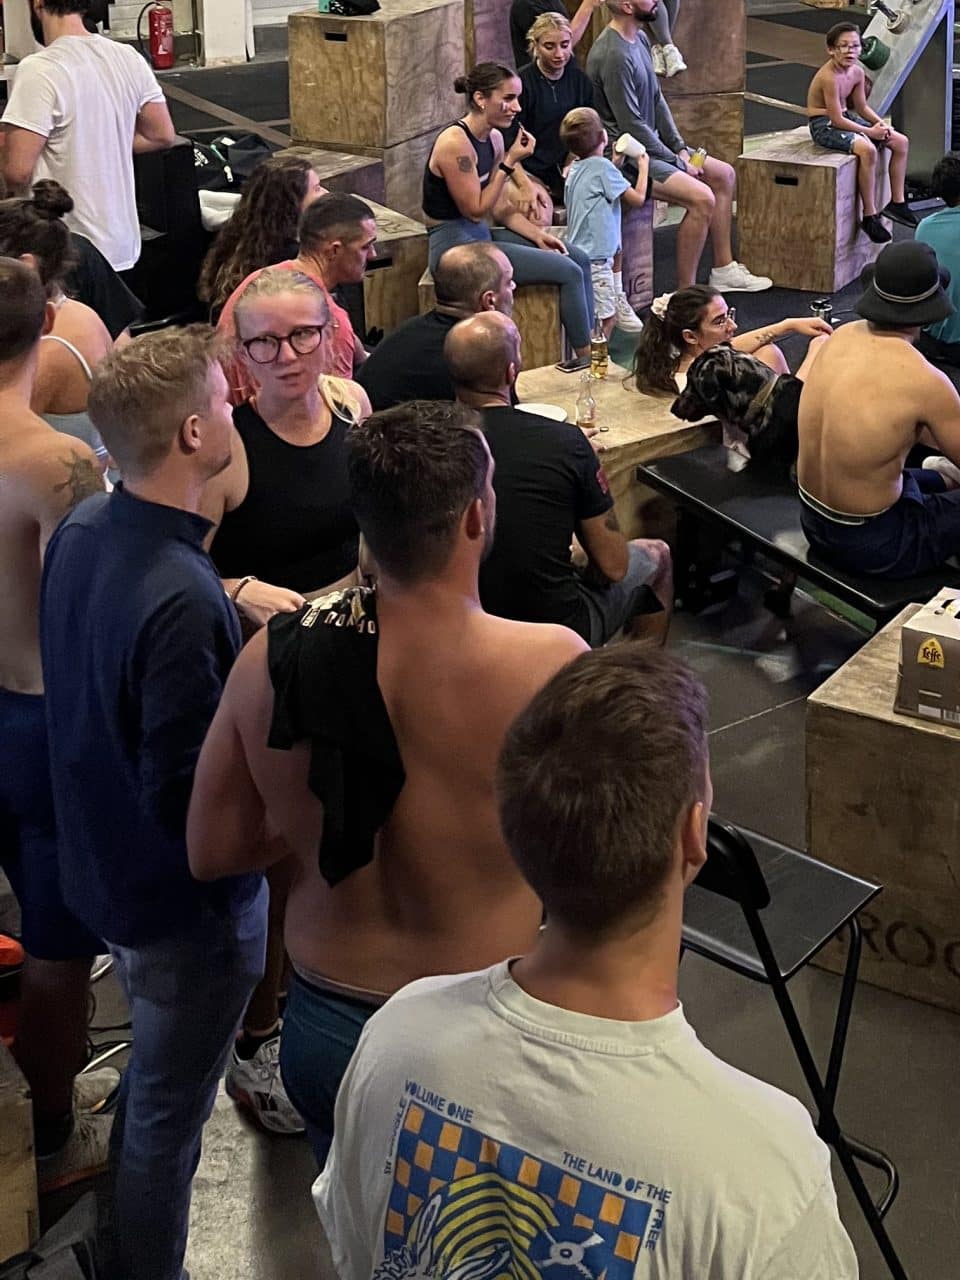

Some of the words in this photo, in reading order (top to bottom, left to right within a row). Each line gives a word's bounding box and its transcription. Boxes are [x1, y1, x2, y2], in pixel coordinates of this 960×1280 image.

[922, 646, 942, 663] Leffe
[405, 1079, 446, 1112] VOLUME
[447, 1102, 474, 1124] ONE
[562, 1151, 588, 1173] THE
[587, 1162, 623, 1187] LAND
[624, 1177, 645, 1193] OF
[646, 1183, 673, 1204] THE
[644, 1208, 666, 1251] FREE
